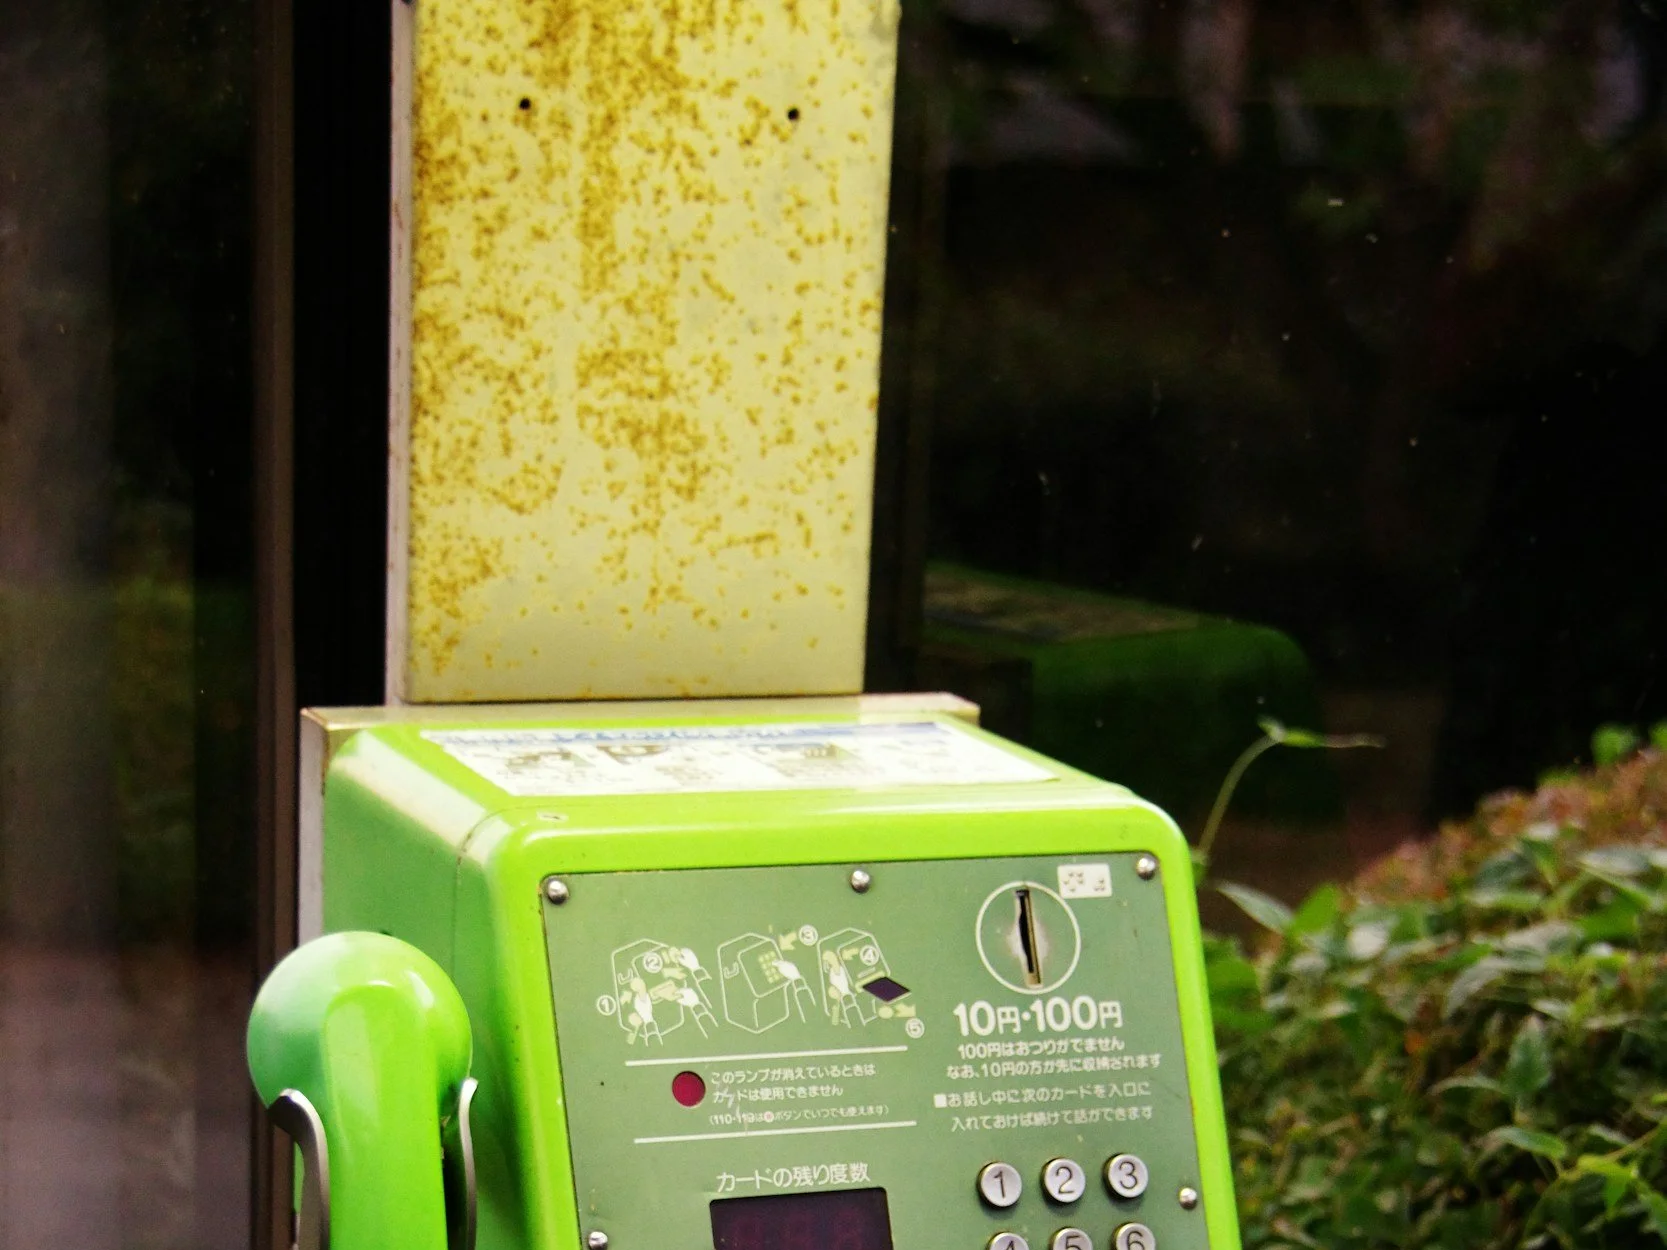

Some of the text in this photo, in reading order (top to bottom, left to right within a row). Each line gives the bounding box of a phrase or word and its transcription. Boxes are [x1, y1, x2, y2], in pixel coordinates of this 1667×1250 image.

[711, 1064, 877, 1086] このランプが消えているときは
[716, 1162, 871, 1192] カードの残り度数
